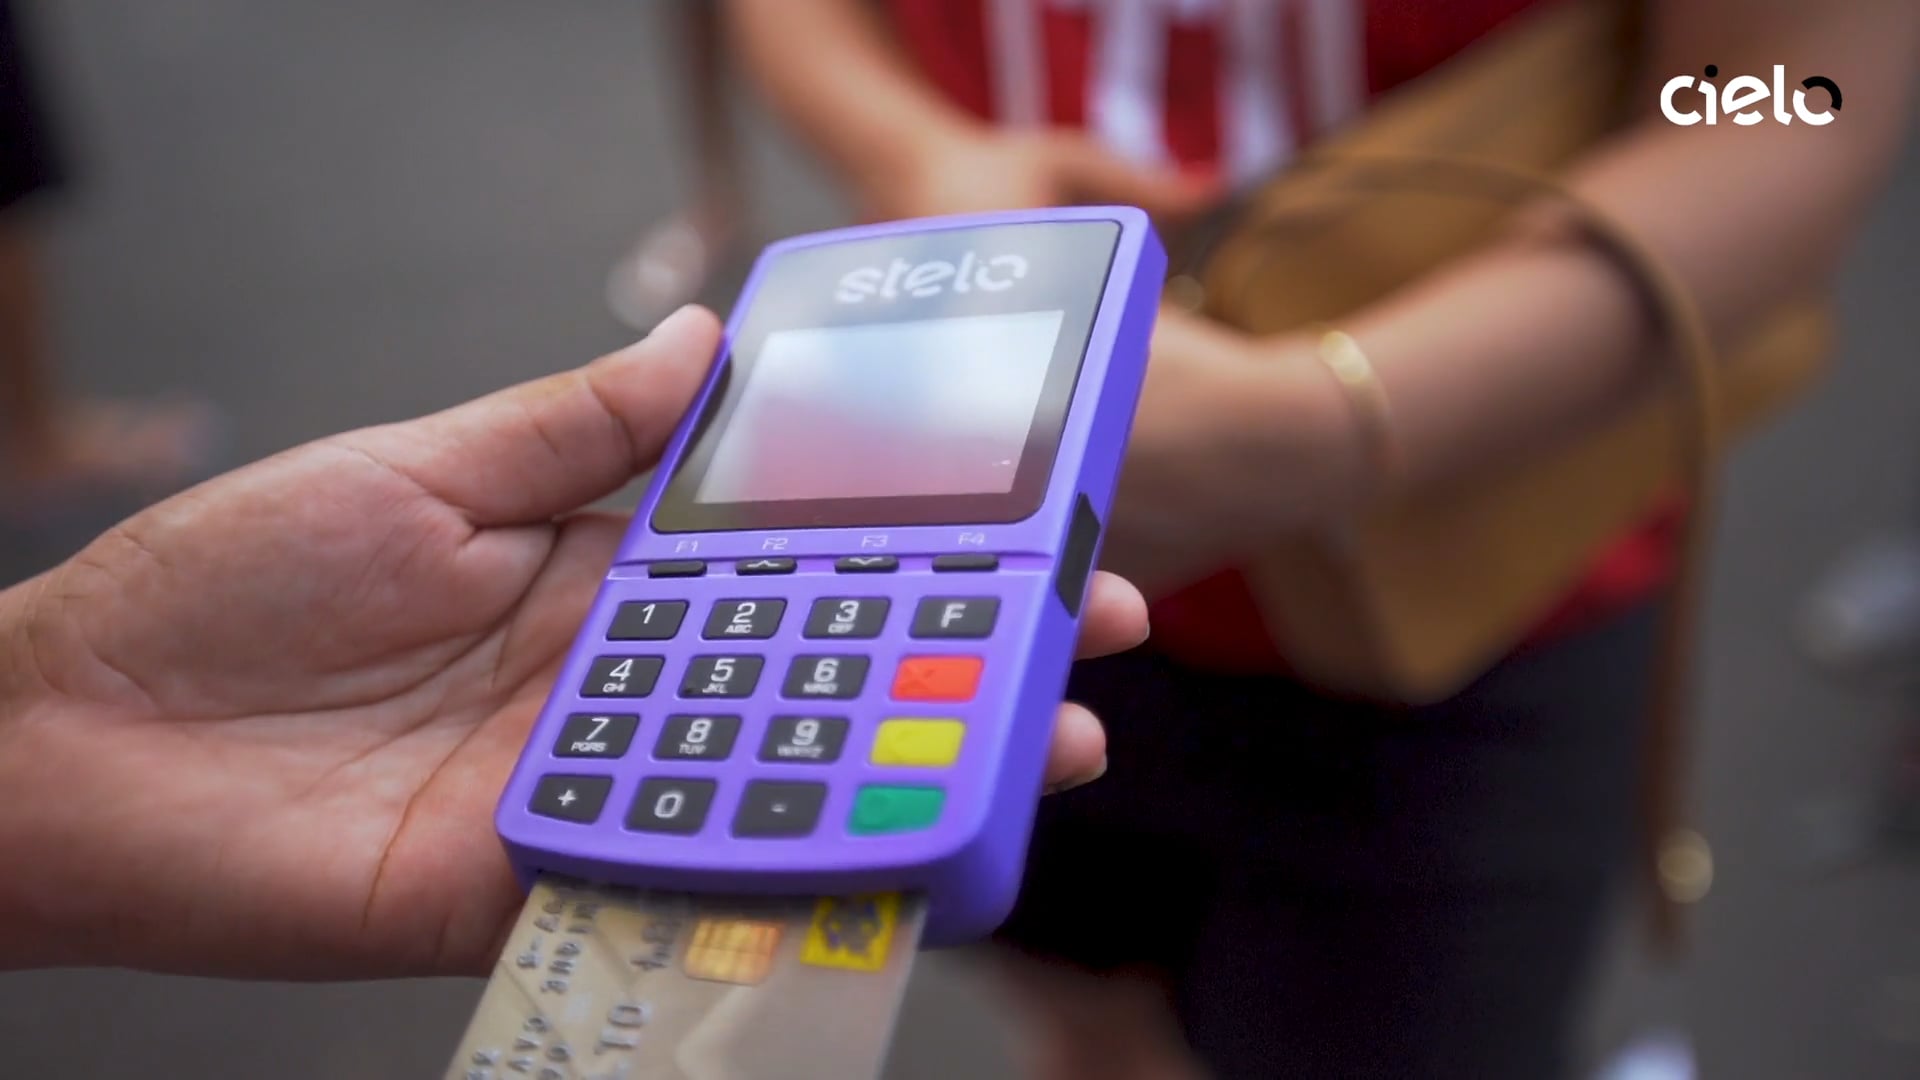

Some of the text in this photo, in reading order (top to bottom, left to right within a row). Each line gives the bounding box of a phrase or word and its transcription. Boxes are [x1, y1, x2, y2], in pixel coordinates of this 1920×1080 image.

[834, 251, 1028, 303] stelo
[675, 540, 698, 553] F1
[762, 537, 788, 551] F2
[861, 535, 888, 548] F3
[641, 603, 656, 624] 1
[733, 602, 756, 624] 2
[835, 600, 859, 623] 3
[940, 602, 966, 628] F
[609, 658, 633, 681] 4
[710, 658, 736, 682] 5
[813, 657, 839, 682] 6
[585, 716, 610, 741] 7
[686, 718, 712, 743] 8
[791, 719, 820, 746] 9
